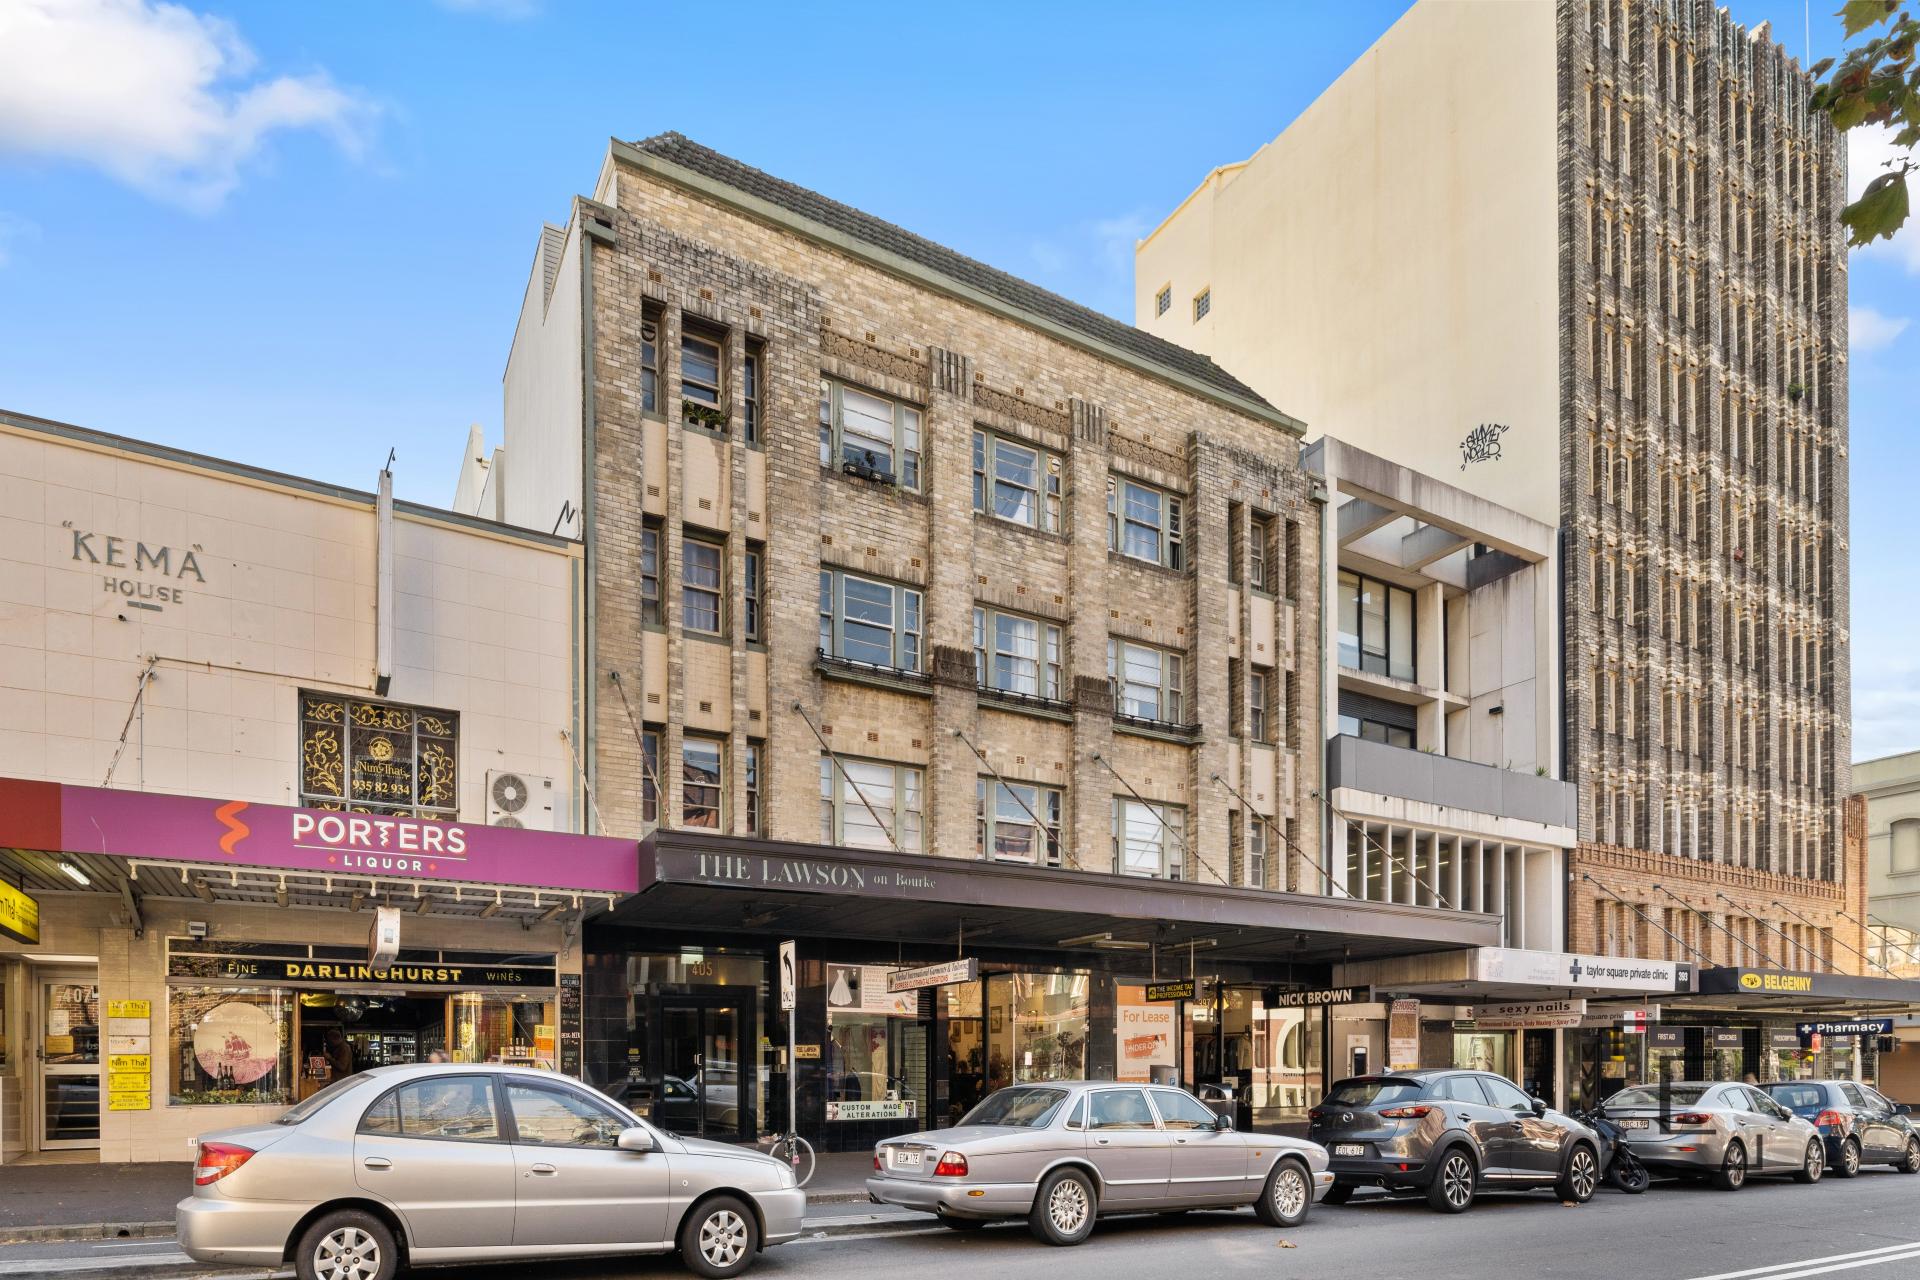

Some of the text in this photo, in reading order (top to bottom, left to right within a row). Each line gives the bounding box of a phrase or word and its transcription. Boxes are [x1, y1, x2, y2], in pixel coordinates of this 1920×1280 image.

[103, 576, 183, 604] HOUSE
[382, 763, 404, 775] Thai
[352, 780, 410, 795] 935 82 934
[293, 813, 467, 854] PORTERS
[344, 855, 422, 871] LIQUOR
[694, 854, 937, 889] THE LAWSON on Bourke
[227, 963, 522, 982] FINE DARLINGHURST WINES
[692, 961, 713, 976] 405
[1586, 964, 1669, 980] taylor square private clinic
[1764, 974, 1812, 991] BELGENNY
[63, 988, 91, 1003] 407
[783, 991, 794, 1002] ONLY
[1156, 990, 1192, 998] PROFESSIONALS
[1279, 989, 1352, 1006] NICK BROWN
[1499, 1005, 1531, 1014] sexy
[1536, 1001, 1571, 1012] nails
[1123, 1010, 1170, 1023] For Lease
[1817, 1022, 1885, 1033] Pharmacy
[1658, 1033, 1669, 1041] FIRST
[1126, 1042, 1147, 1053] UNDER
[111, 1058, 147, 1066] Nim Thai
